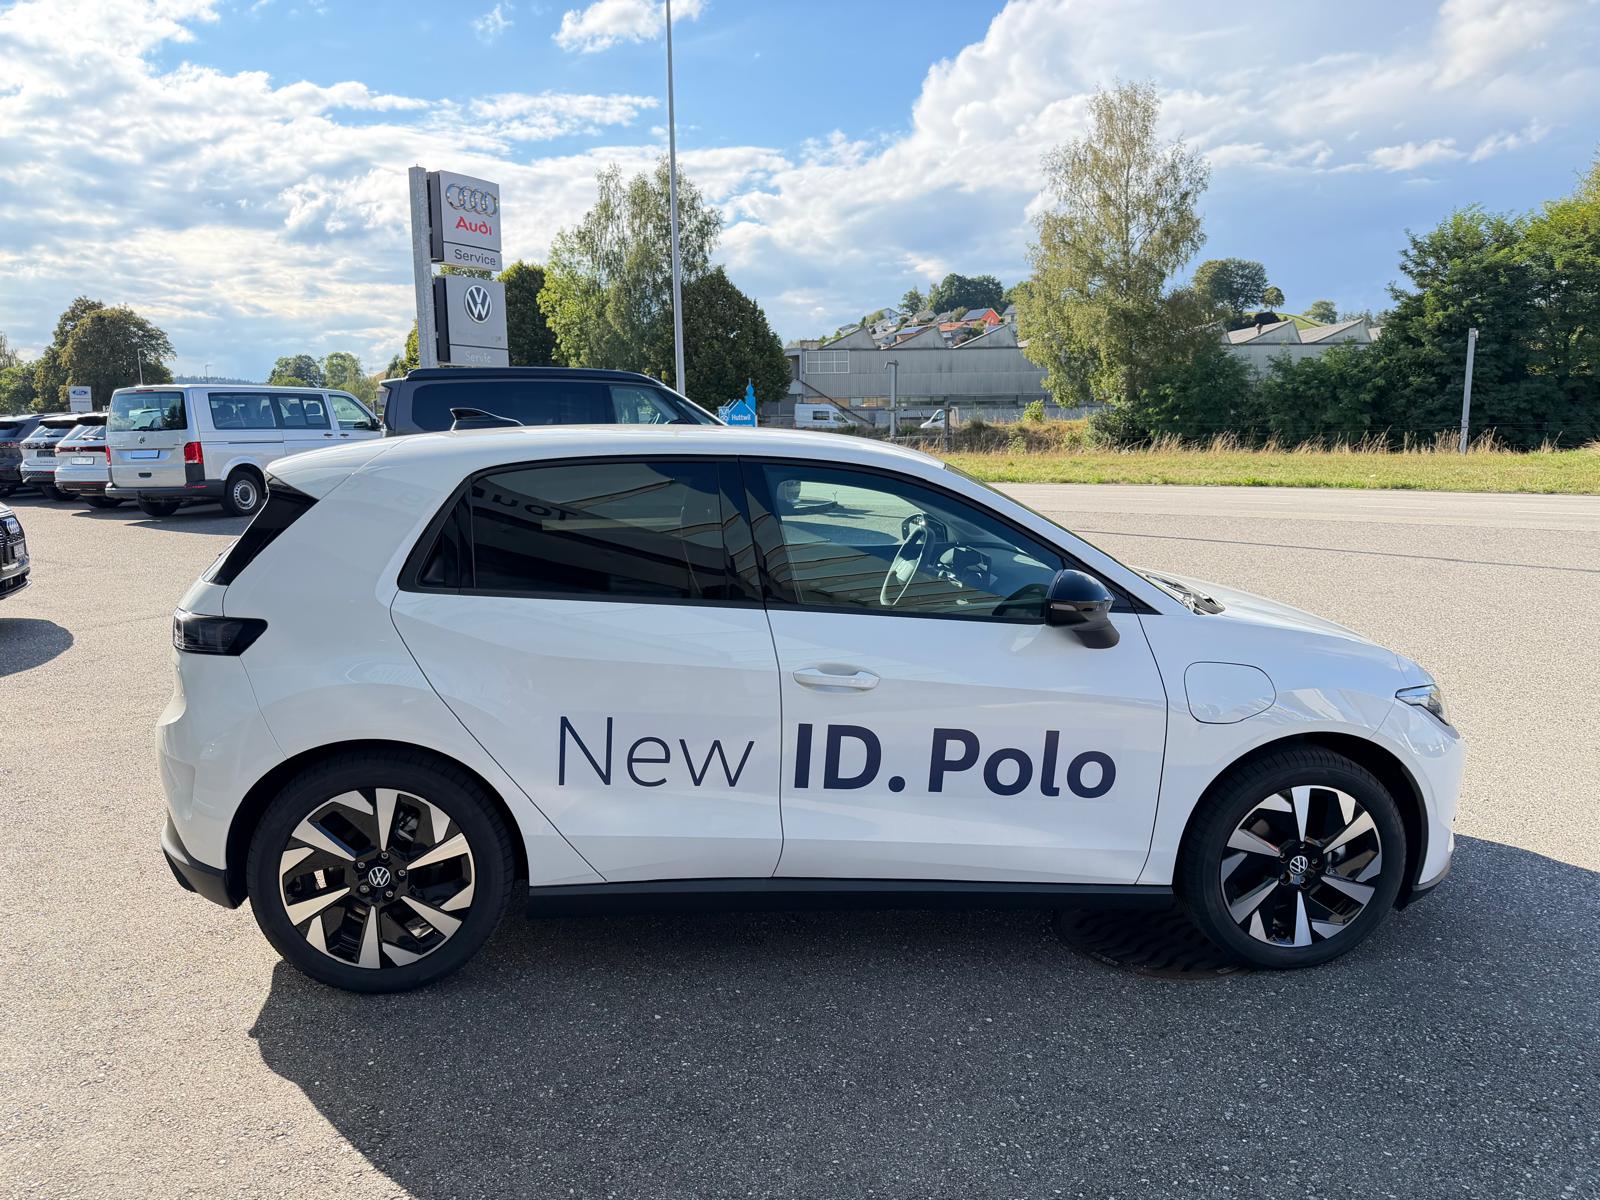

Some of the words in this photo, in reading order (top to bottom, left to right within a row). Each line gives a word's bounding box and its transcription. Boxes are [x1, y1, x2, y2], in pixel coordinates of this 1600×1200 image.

[455, 216, 493, 236] Audi
[454, 249, 497, 266] Service
[557, 716, 756, 787] New
[794, 723, 906, 793] ID.
[928, 727, 1117, 799] Polo
